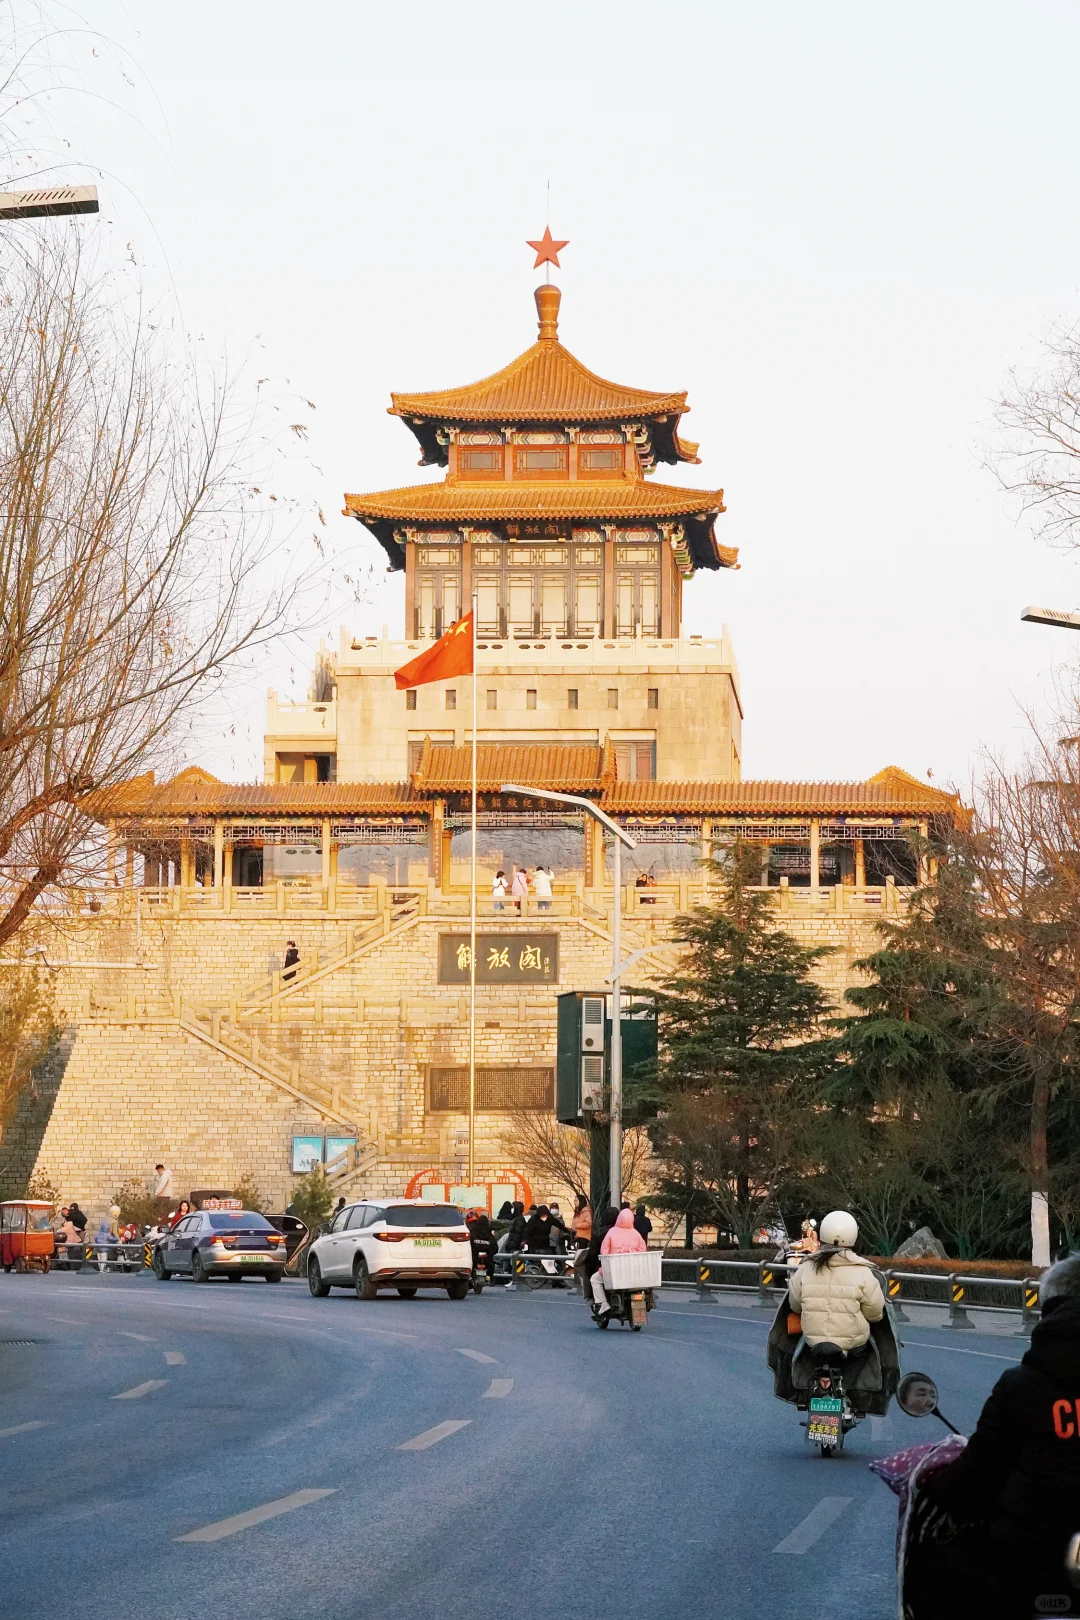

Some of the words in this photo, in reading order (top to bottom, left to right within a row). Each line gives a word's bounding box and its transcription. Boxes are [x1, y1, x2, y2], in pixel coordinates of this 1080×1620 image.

[506, 523, 560, 536] 解放阁
[456, 943, 542, 971] 解放阁
